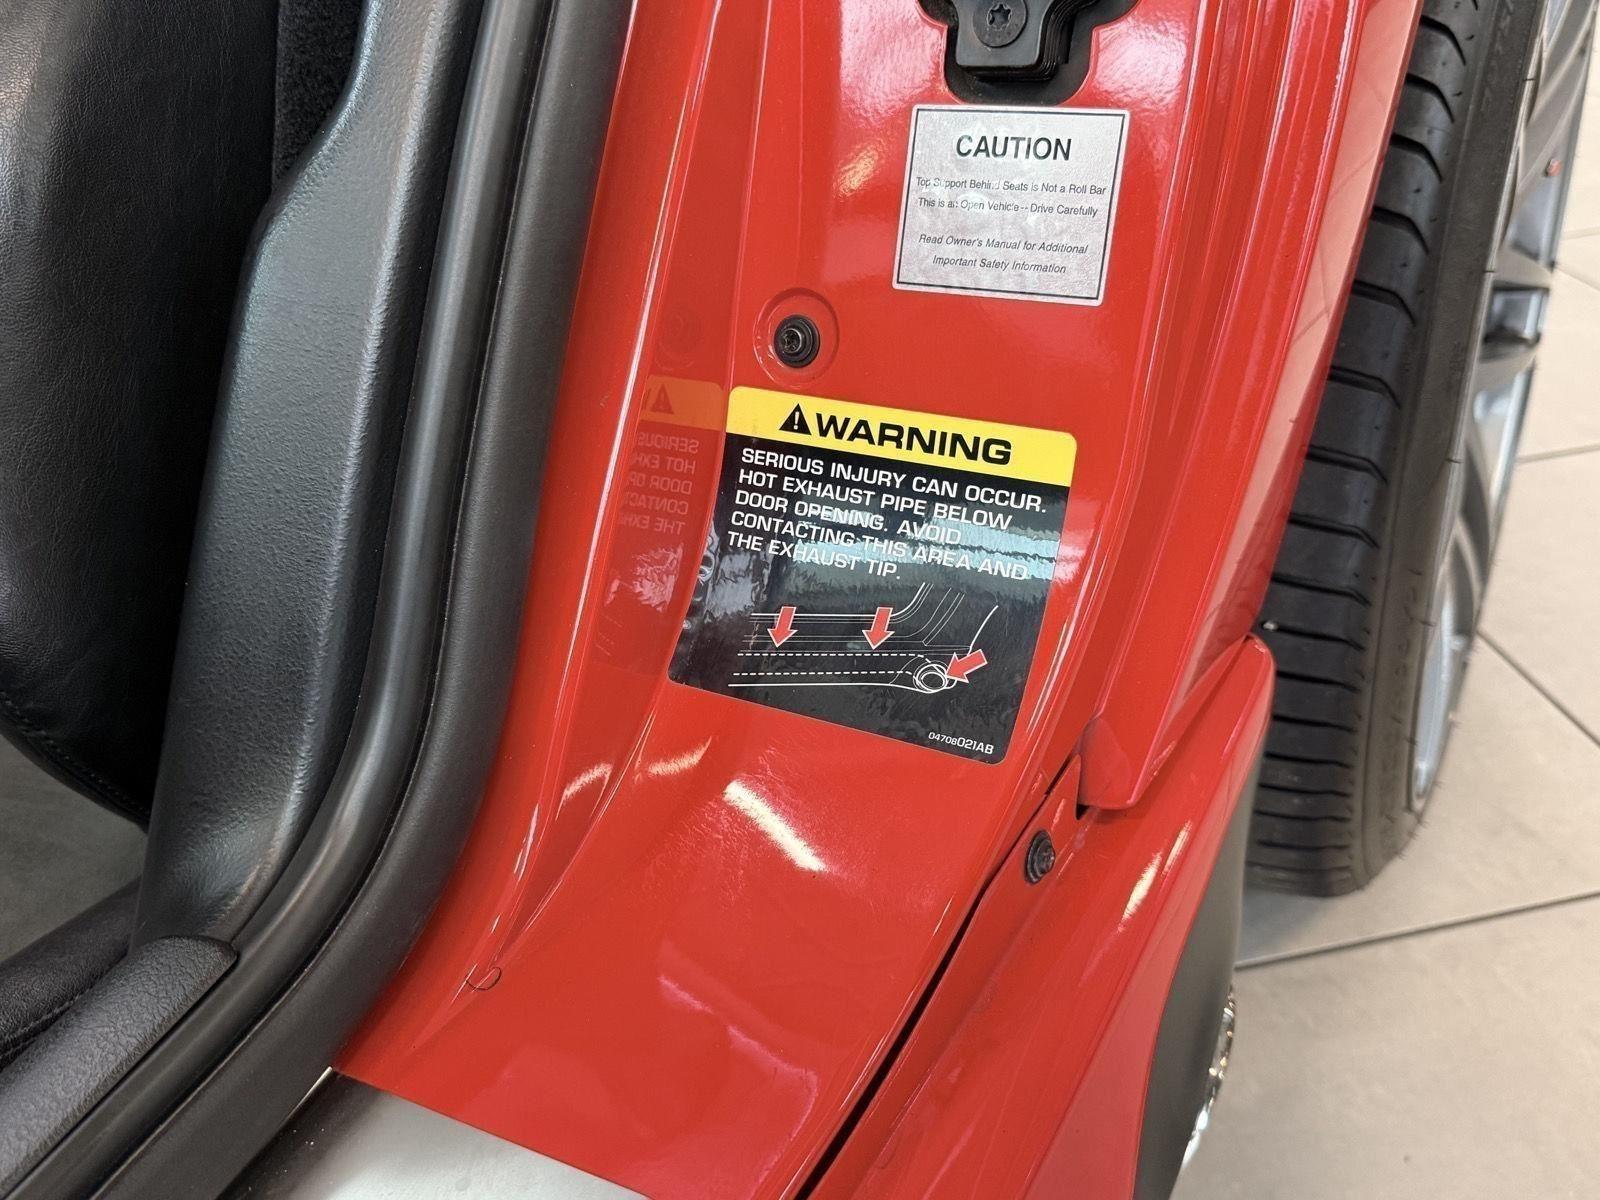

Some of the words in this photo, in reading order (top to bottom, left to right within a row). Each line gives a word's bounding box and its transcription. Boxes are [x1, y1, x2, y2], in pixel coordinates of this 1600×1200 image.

[956, 134, 1072, 161] CAUTION
[916, 176, 931, 188] Top
[1002, 180, 1029, 192] Seats
[1030, 182, 1039, 192] is
[1041, 182, 1058, 193] Not
[1059, 185, 1066, 193] a
[1068, 183, 1087, 194] Roll
[1089, 184, 1107, 195] Bar
[918, 197, 936, 208] This
[937, 198, 945, 208] is
[960, 199, 985, 212] Open
[987, 200, 1020, 212] Vehicle
[1029, 203, 1054, 213] Drive
[1056, 204, 1099, 218] Carefully
[918, 233, 943, 245] Read
[945, 235, 983, 247] Owner's
[986, 237, 1021, 250] Manual
[1023, 240, 1037, 251] for
[1038, 241, 1089, 254] Additional
[932, 254, 978, 267] Important
[979, 258, 1010, 271] Safety
[1011, 261, 1067, 274] Information
[815, 412, 1012, 466] WARNING
[738, 468, 778, 489] HOT
[782, 476, 876, 507] EXHAUST
[880, 493, 928, 516] PIPE
[933, 502, 1013, 530] BELOW
[741, 448, 825, 476] SERIOUS
[830, 462, 907, 489] INJURY
[911, 476, 959, 499] CAN
[964, 485, 1047, 514] OCCUR.
[734, 489, 789, 513] DOOR
[794, 500, 888, 532] OPENING.
[896, 519, 962, 545] AVOID
[727, 530, 764, 552] THE
[768, 539, 860, 571] EXHAUST
[867, 559, 901, 580] TIP.
[731, 510, 856, 547] CONTACTING
[862, 534, 908, 558] THIS
[911, 545, 971, 571] AREA
[977, 558, 1029, 581] AND
[928, 731, 995, 755] 04708021AB
